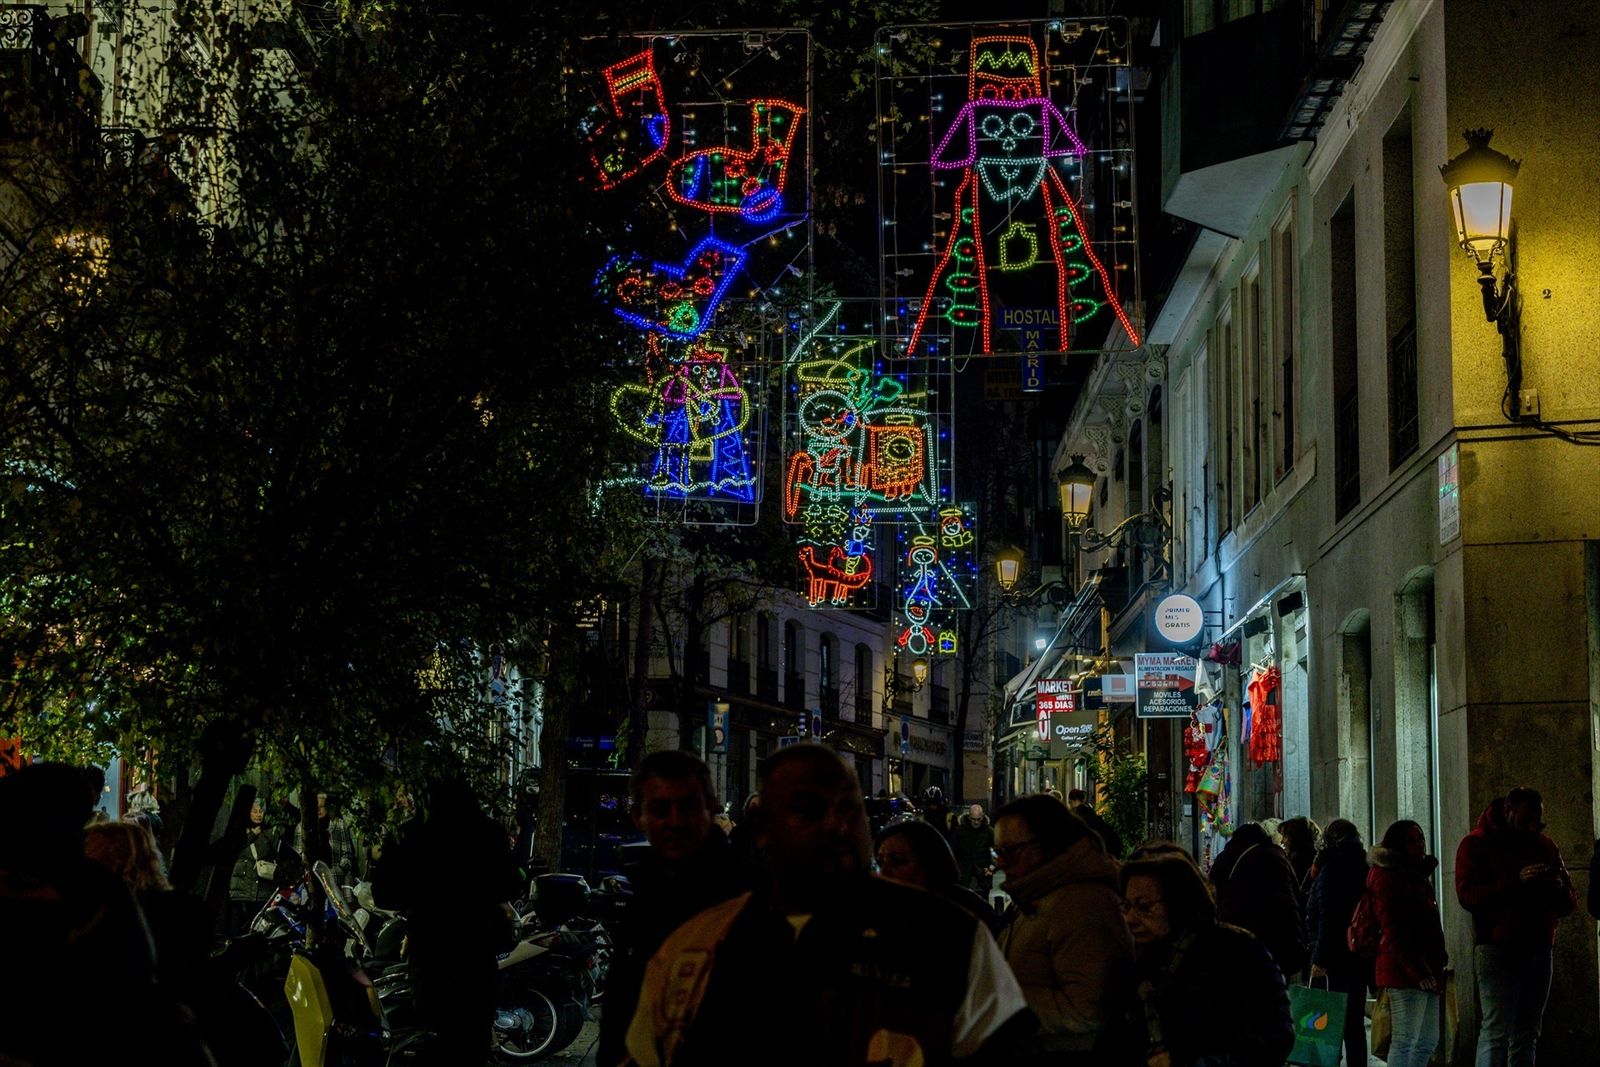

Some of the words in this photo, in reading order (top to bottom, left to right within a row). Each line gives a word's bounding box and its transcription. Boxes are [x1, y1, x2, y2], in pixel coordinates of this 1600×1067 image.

[1542, 288, 1552, 299] 2
[1004, 309, 1059, 325] HOSTAL
[1138, 657, 1162, 666] MYMA
[1037, 680, 1073, 694] MARKET
[1038, 701, 1053, 709] 365
[1055, 700, 1074, 709] DIAS
[1143, 705, 1193, 713] REPARACIONES
